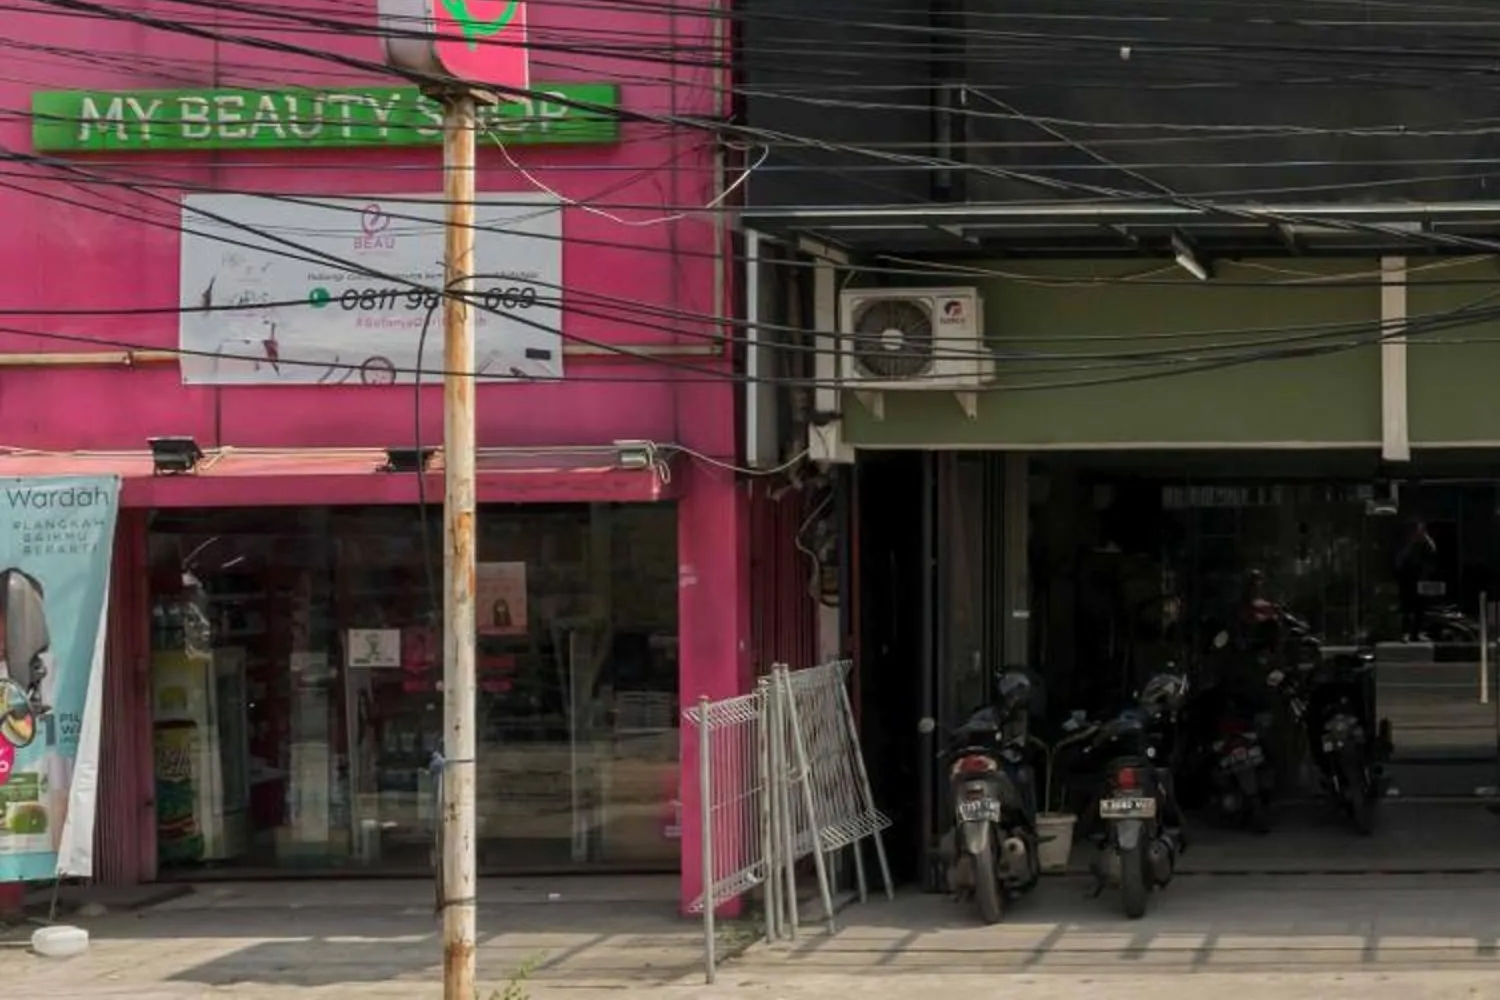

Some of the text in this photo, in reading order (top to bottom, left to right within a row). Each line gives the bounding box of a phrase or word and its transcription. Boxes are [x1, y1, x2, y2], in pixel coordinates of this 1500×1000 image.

[78, 97, 161, 141] MY
[176, 93, 400, 140] BEAUTY
[354, 236, 395, 249] BEAU
[341, 287, 396, 311] 0811
[6, 486, 109, 509] Wardah
